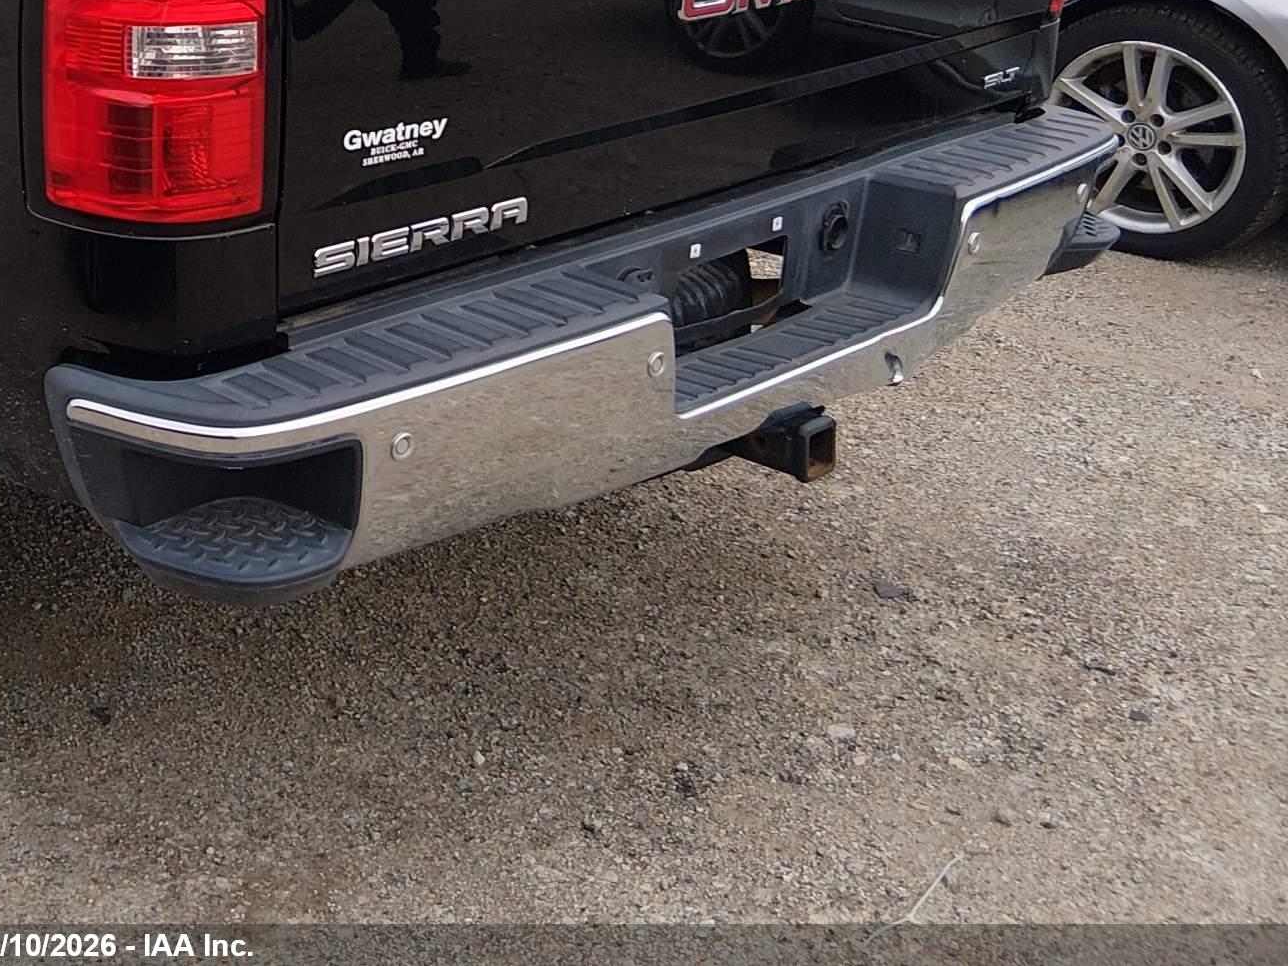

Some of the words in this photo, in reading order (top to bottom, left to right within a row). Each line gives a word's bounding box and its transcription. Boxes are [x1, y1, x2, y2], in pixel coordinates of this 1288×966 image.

[343, 117, 448, 151] Gwatney
[370, 140, 419, 156] BUICK-GMC
[313, 196, 528, 278] SIERRA
